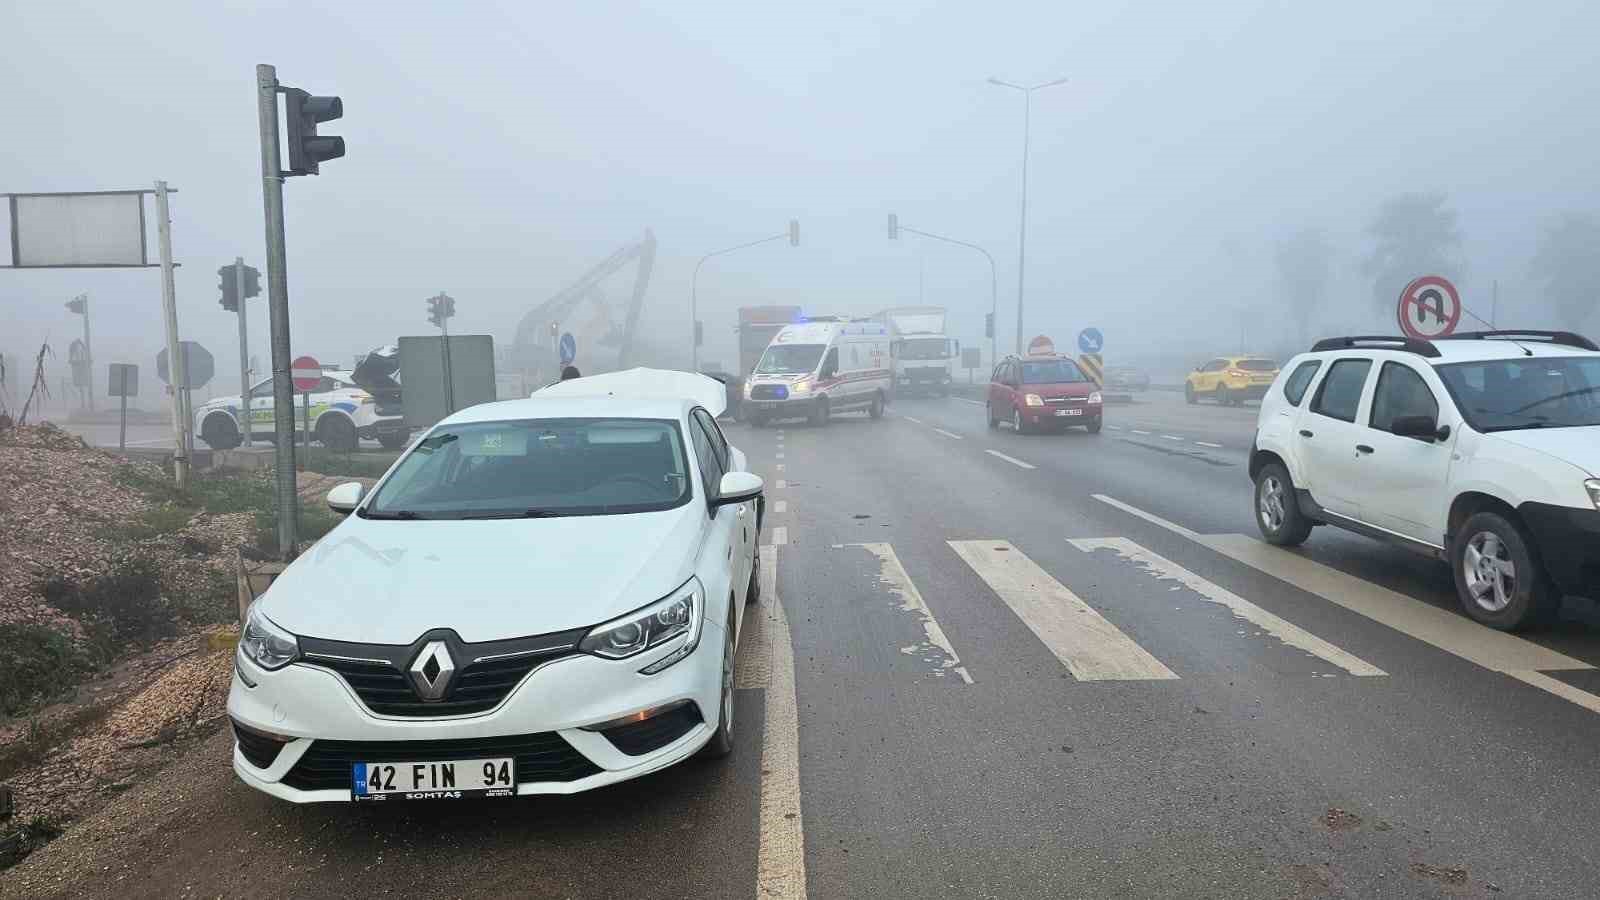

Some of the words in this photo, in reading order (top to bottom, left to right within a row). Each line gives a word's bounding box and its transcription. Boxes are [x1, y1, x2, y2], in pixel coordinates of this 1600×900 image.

[356, 781, 366, 789] TR
[369, 765, 397, 791] 42
[412, 763, 456, 790] FIN
[483, 761, 510, 786] 94
